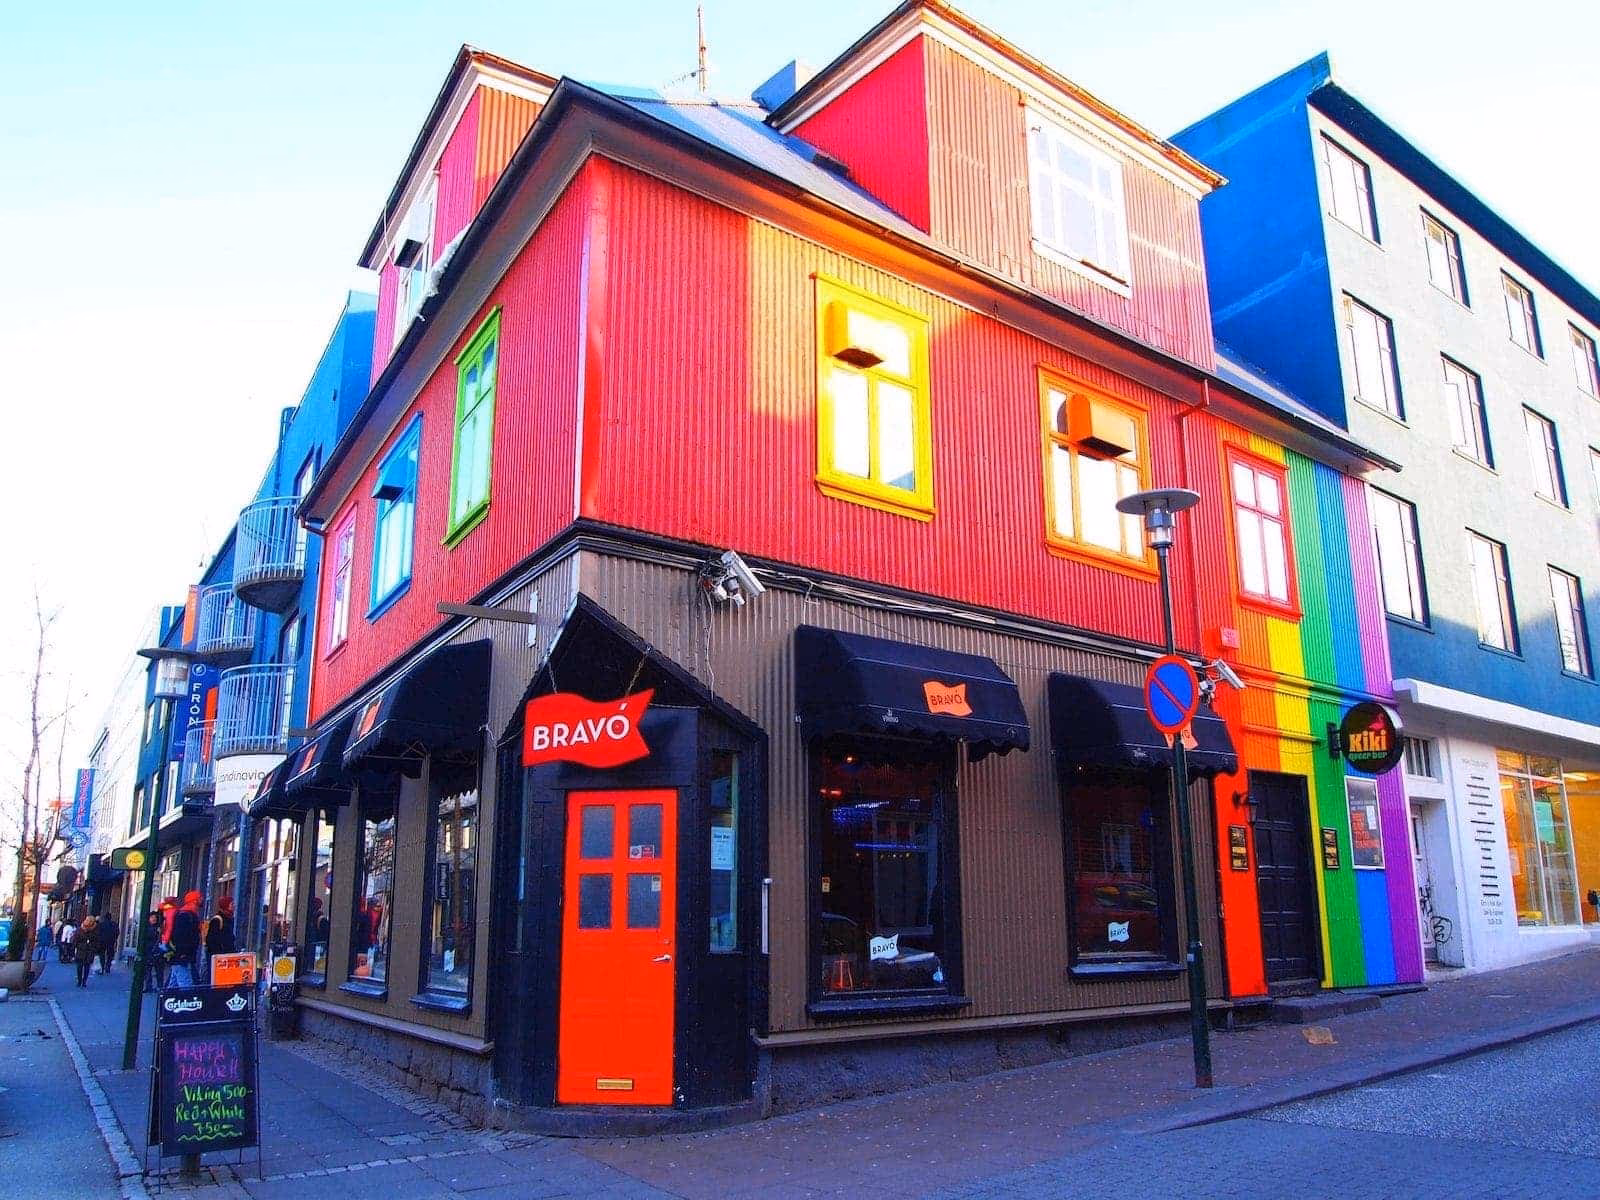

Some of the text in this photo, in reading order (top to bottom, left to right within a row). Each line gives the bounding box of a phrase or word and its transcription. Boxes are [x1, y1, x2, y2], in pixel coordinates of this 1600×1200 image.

[930, 688, 962, 706] BRAVÓ
[532, 702, 630, 751] BRAVÓ
[164, 997, 203, 1013] Carlsberg
